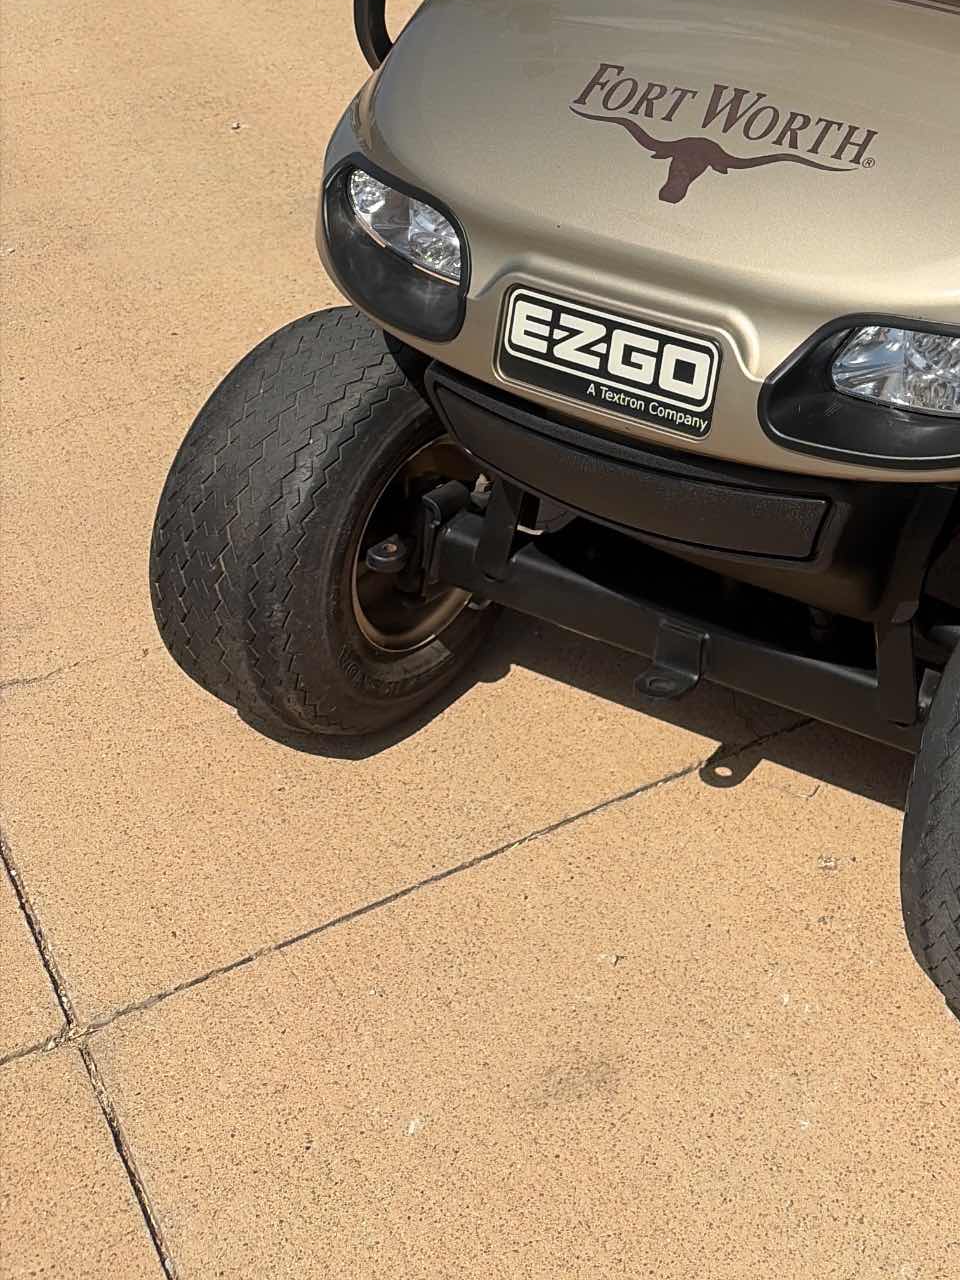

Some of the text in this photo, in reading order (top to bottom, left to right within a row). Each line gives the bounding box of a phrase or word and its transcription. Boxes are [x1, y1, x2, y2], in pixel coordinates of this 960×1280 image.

[573, 63, 878, 165] FORT WORTH
[586, 383, 709, 432] A Textron Company
